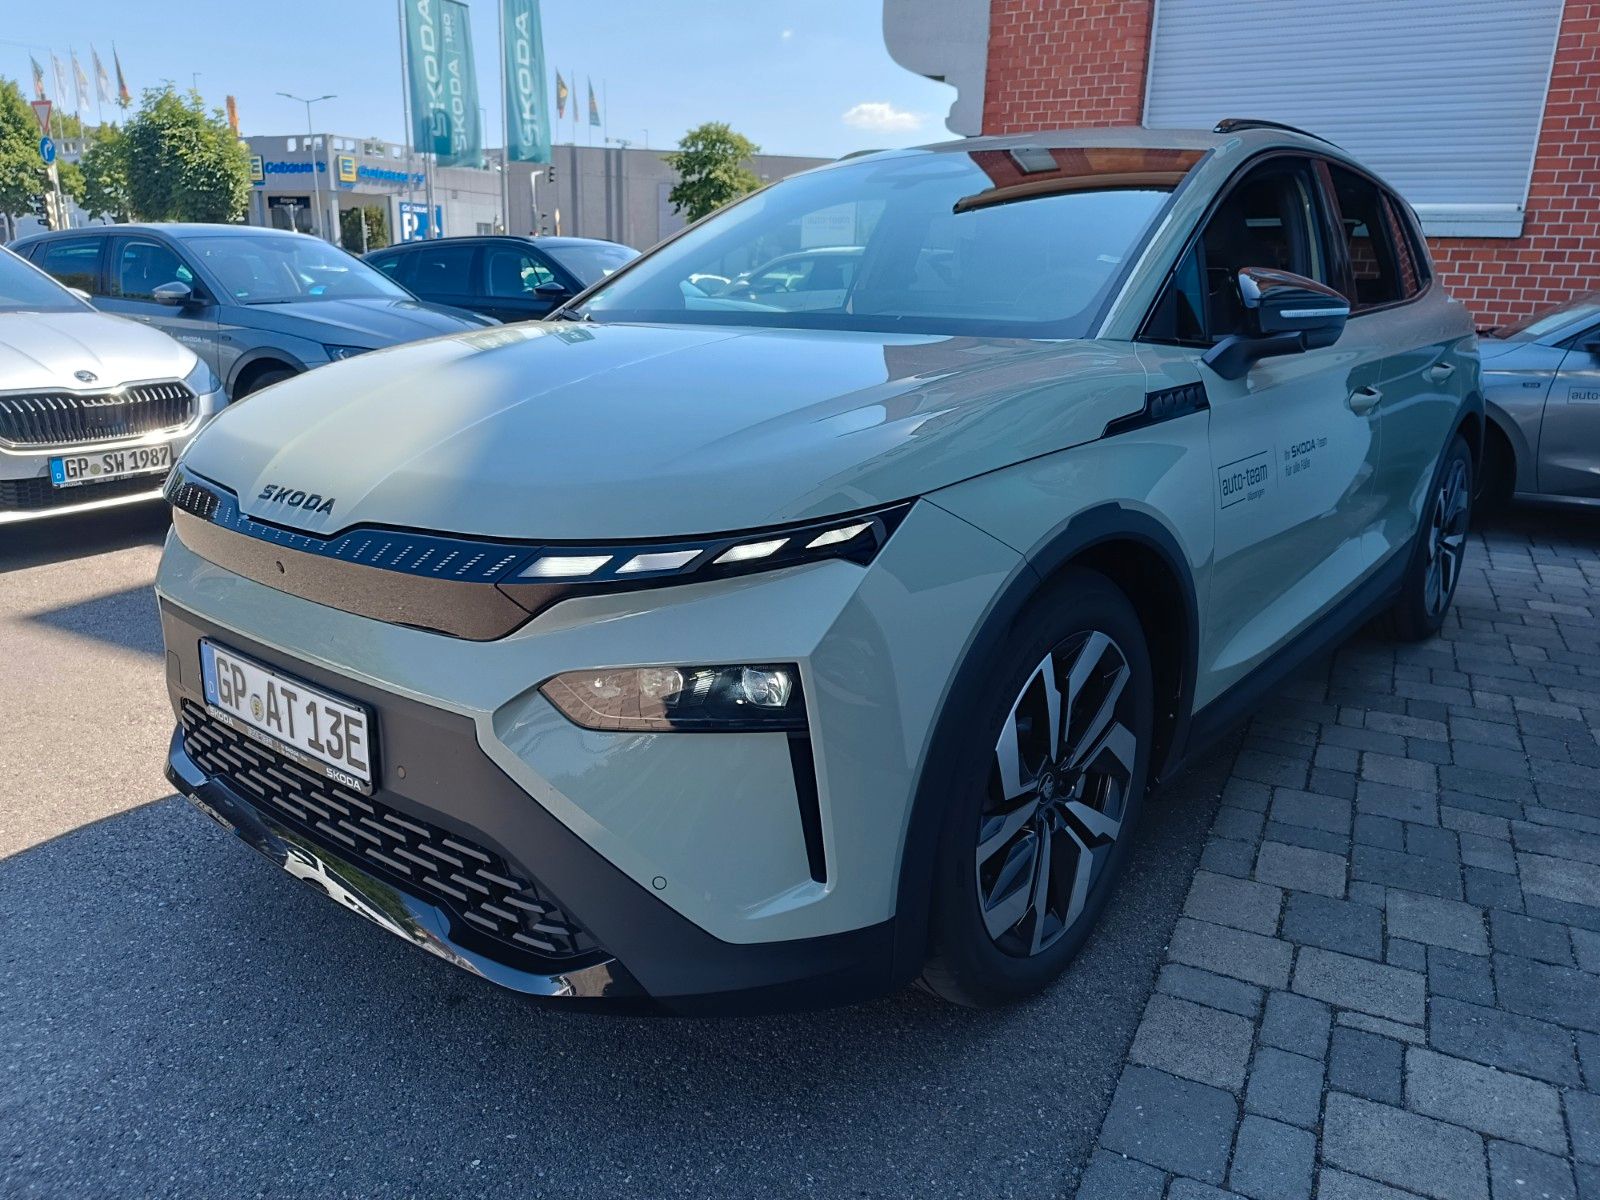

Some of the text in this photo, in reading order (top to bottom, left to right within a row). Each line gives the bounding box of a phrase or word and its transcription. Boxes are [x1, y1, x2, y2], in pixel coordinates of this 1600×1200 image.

[65, 446, 169, 478] GP SW 1987
[1222, 464, 1269, 496] auto-team
[258, 484, 336, 516] SKODA
[209, 706, 234, 727] SKODA
[216, 656, 368, 772] GP AT 13E
[326, 767, 362, 791] SKODA
